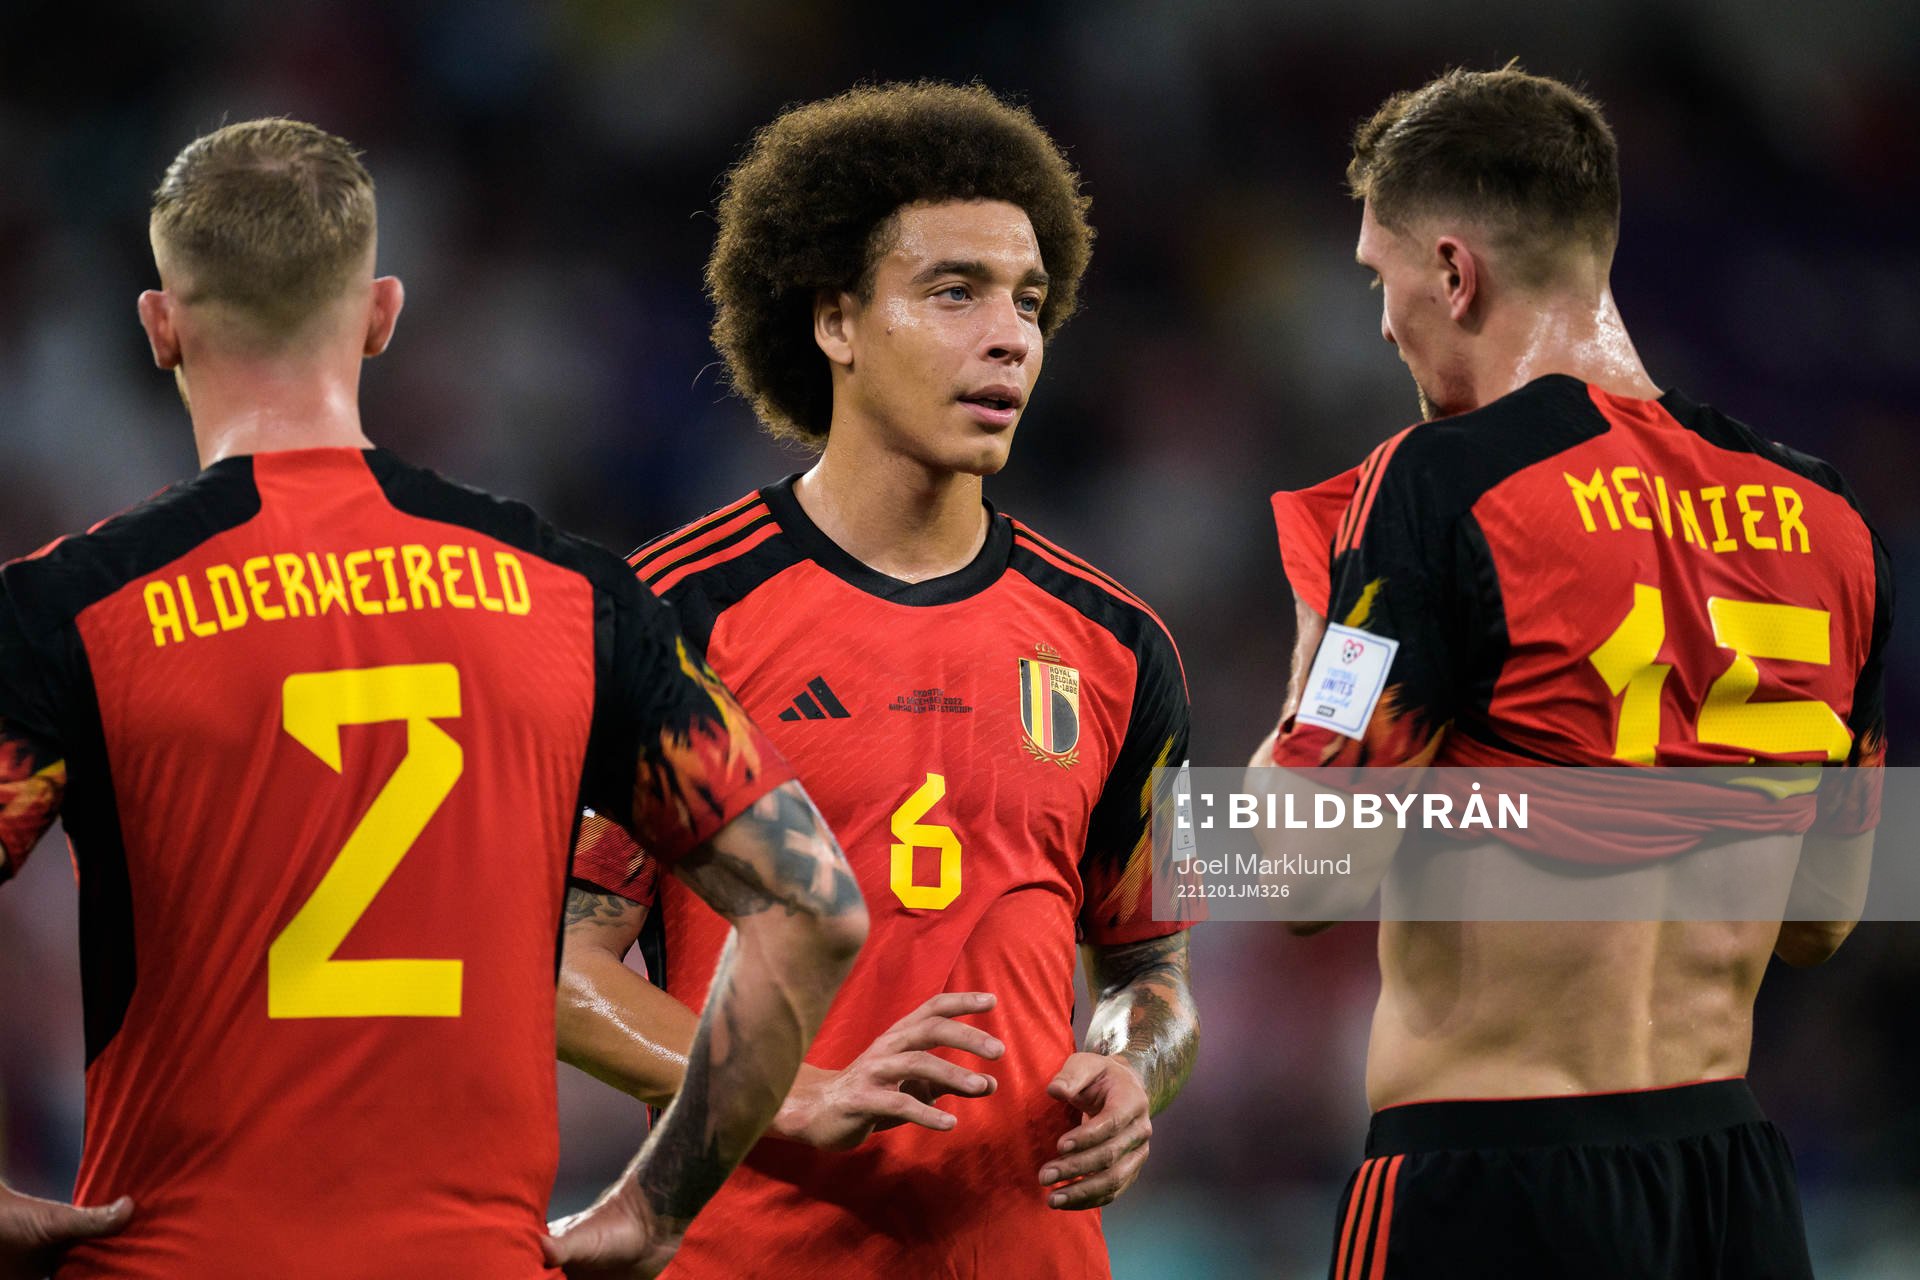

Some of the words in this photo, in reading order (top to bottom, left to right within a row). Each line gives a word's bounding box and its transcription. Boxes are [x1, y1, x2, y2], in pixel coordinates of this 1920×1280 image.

[143, 543, 531, 647] ALDERWEIRELD
[944, 697, 963, 706] 2022
[1050, 667, 1071, 677] ROYAL
[1051, 674, 1078, 687] BELGIAN
[1588, 582, 1853, 799] 15
[268, 662, 464, 1018] 2
[890, 773, 962, 910] 6
